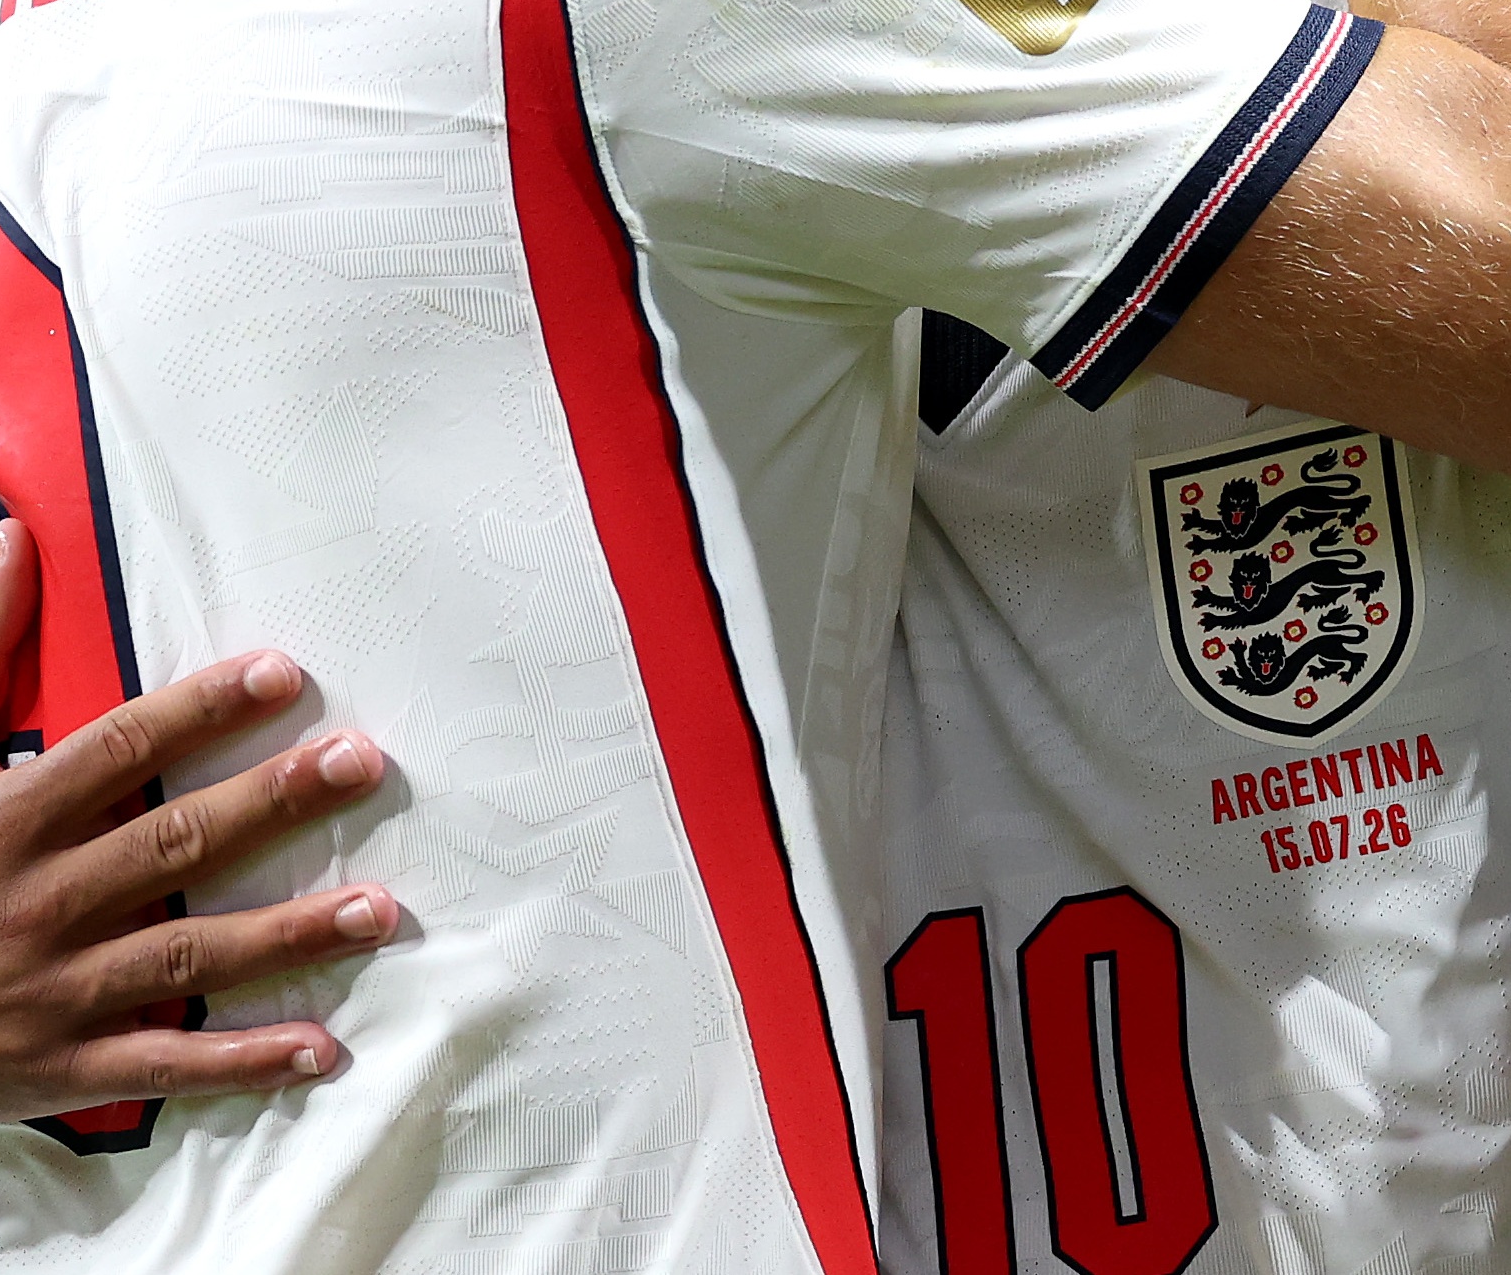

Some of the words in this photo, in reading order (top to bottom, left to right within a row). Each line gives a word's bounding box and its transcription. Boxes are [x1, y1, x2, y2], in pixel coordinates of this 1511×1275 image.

[1210, 734, 1444, 825] ARGENTINA
[1260, 803, 1412, 874] 15.07.26
[884, 884, 1219, 1275] 10
